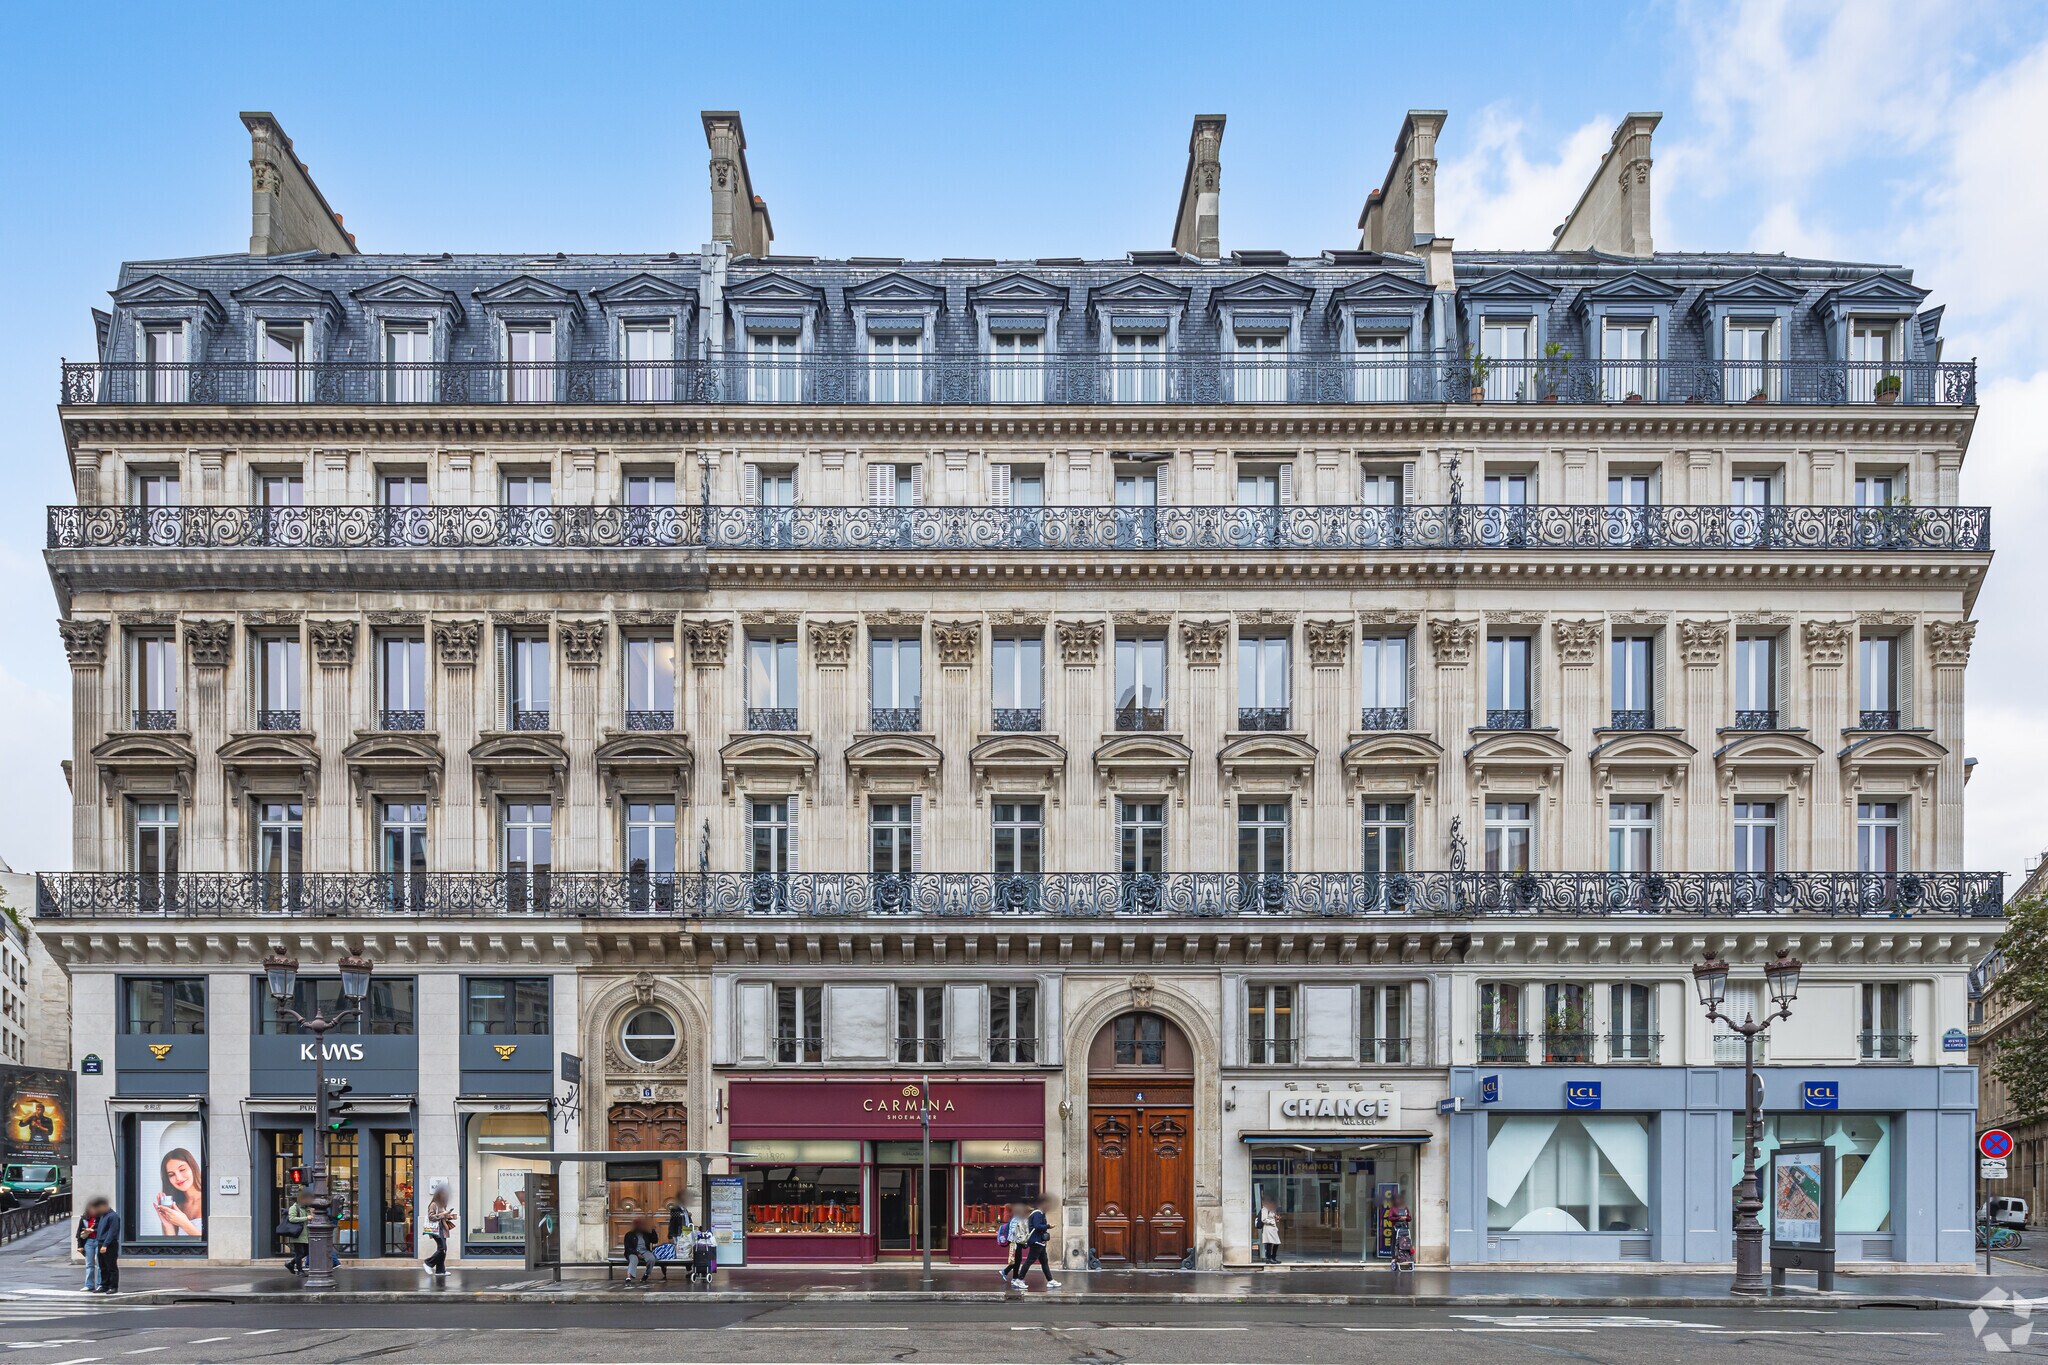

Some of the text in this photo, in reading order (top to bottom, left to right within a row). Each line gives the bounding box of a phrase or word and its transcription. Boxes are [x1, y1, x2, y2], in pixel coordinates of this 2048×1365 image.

[1484, 1082, 1497, 1092] LCL
[1570, 1087, 1598, 1097] LCL
[1807, 1087, 1835, 1097] LCL
[863, 1099, 955, 1112] CARMINA
[1282, 1099, 1389, 1118] CHANGE
[1342, 1118, 1377, 1126] Master
[1002, 1142, 1011, 1154] 4
[1251, 1163, 1278, 1171] ANGE
[1296, 1162, 1335, 1171] CHANGE
[1383, 1190, 1393, 1247] CHANGE
